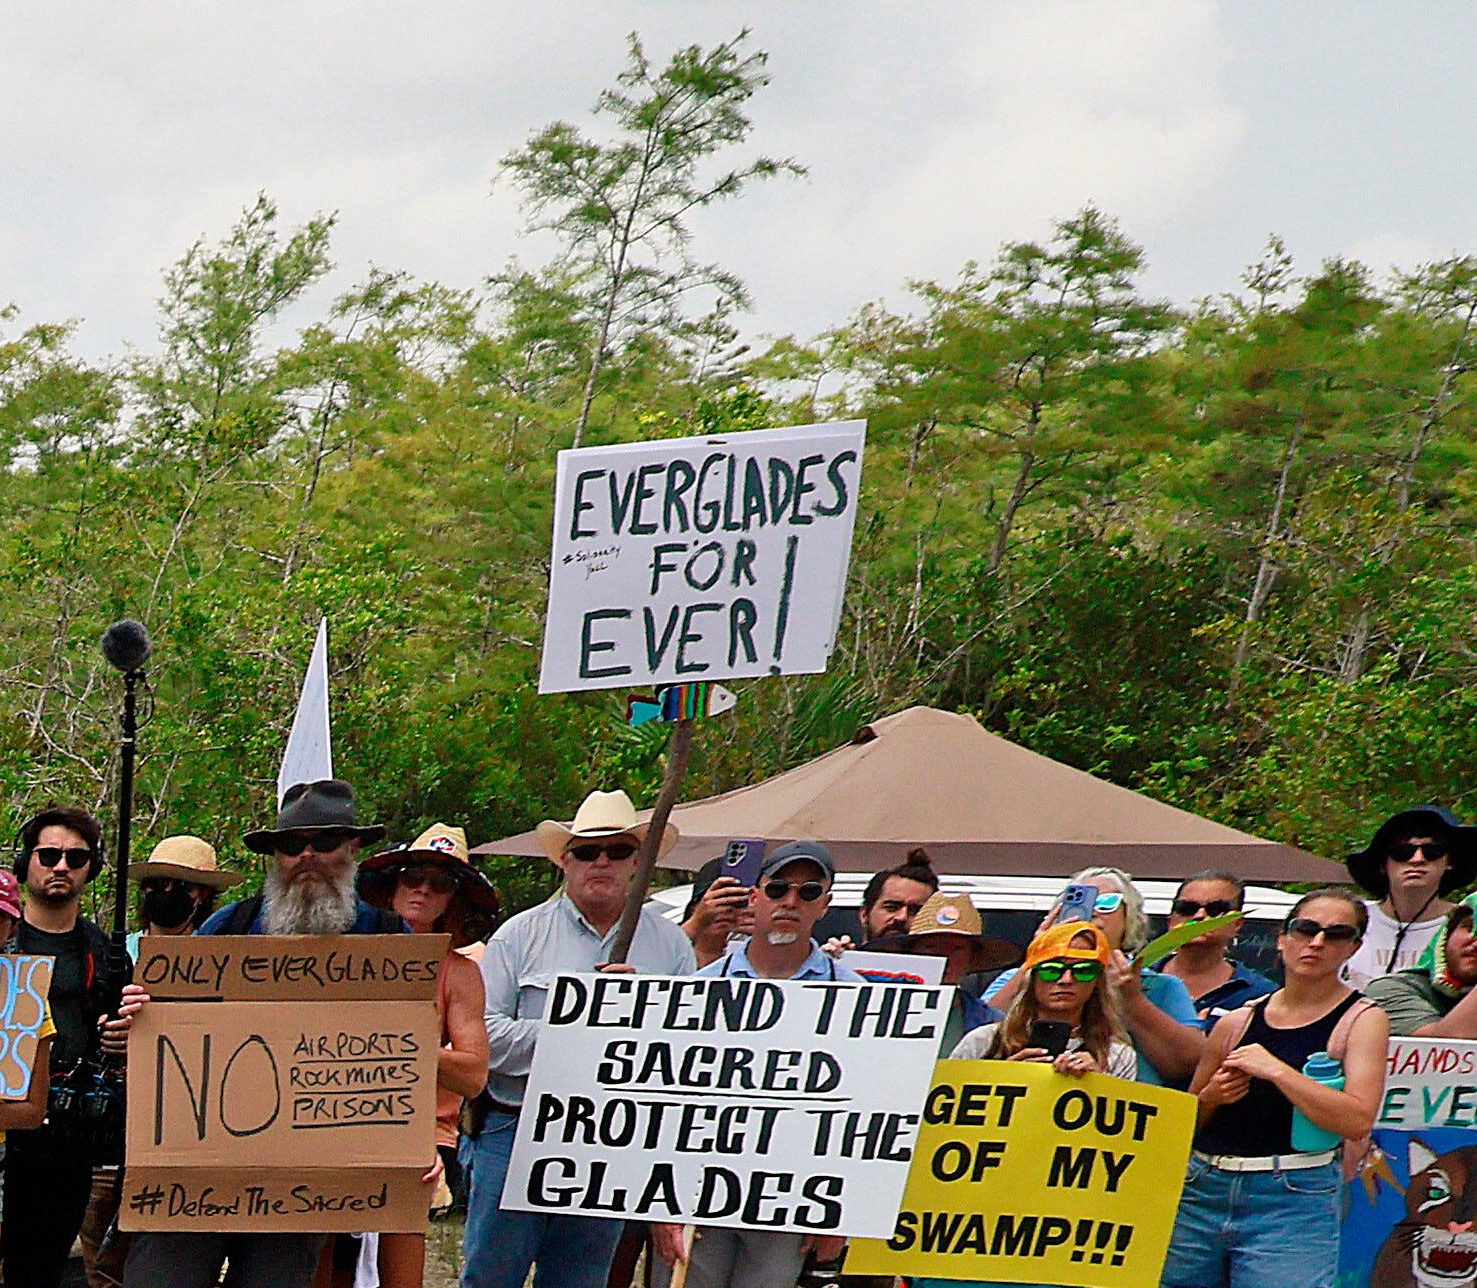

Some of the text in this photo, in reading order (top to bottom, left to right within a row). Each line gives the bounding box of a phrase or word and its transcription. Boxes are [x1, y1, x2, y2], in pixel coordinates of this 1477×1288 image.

[570, 450, 857, 541] EVERGLADES
[649, 539, 756, 595] FOR
[142, 951, 440, 991] ONLY EVERGLADES
[548, 975, 941, 1039] DEFEND THE
[293, 1032, 420, 1059] AIRPORTS
[595, 1040, 842, 1094] SACRED
[1385, 1043, 1475, 1077] HANDS
[153, 1034, 281, 1147] NO
[293, 1094, 416, 1121] PRISONS
[922, 1083, 1159, 1142] GET OUT
[1378, 1085, 1477, 1128] EVE
[531, 1093, 920, 1163] PROTECT THE
[526, 1156, 845, 1231] GLADES
[930, 1140, 1136, 1193] OF MY
[886, 1210, 1134, 1267] SWAMP!!!
